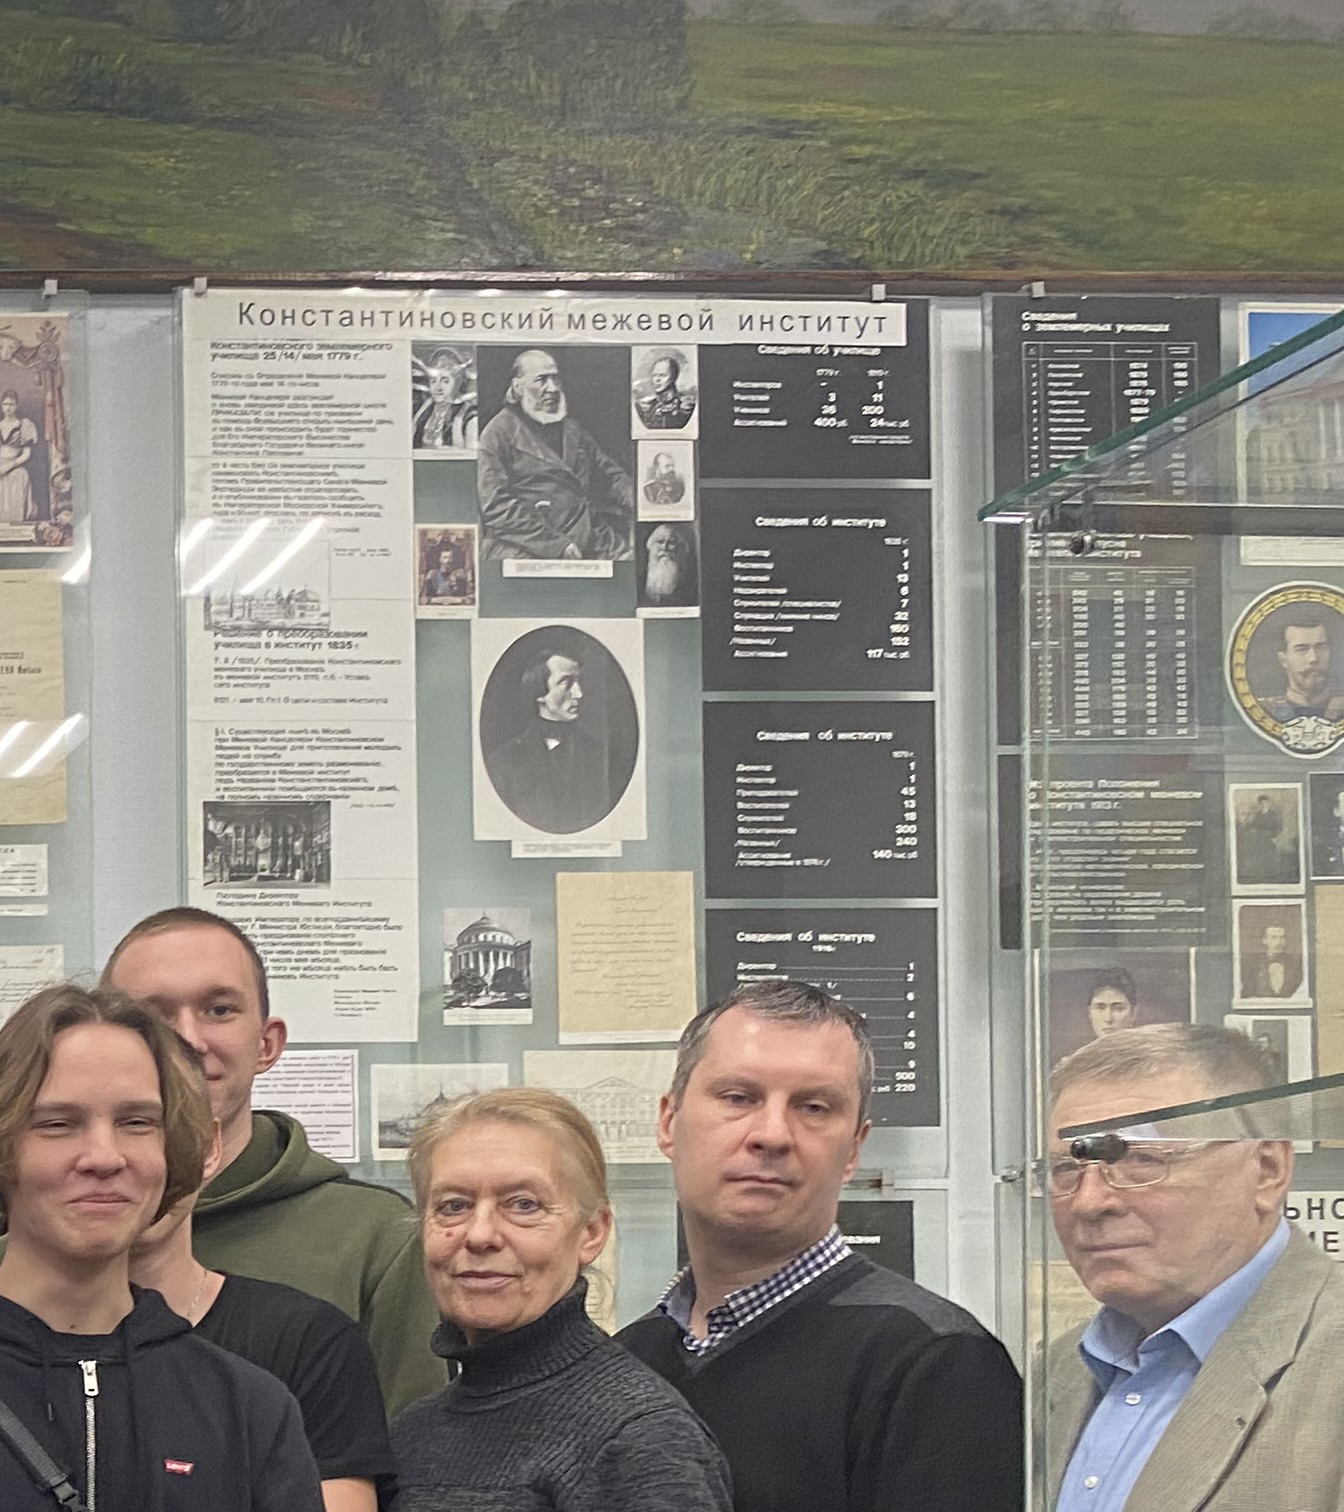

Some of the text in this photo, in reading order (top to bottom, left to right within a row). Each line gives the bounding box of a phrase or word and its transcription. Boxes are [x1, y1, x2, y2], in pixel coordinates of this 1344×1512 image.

[238, 302, 889, 339] Константиновский межевой институт
[327, 351, 351, 361] 1779
[812, 515, 828, 527] об
[274, 640, 323, 651] институт
[756, 730, 810, 741] Сведения
[817, 728, 834, 741] об
[736, 930, 876, 945] Сведения об институте
